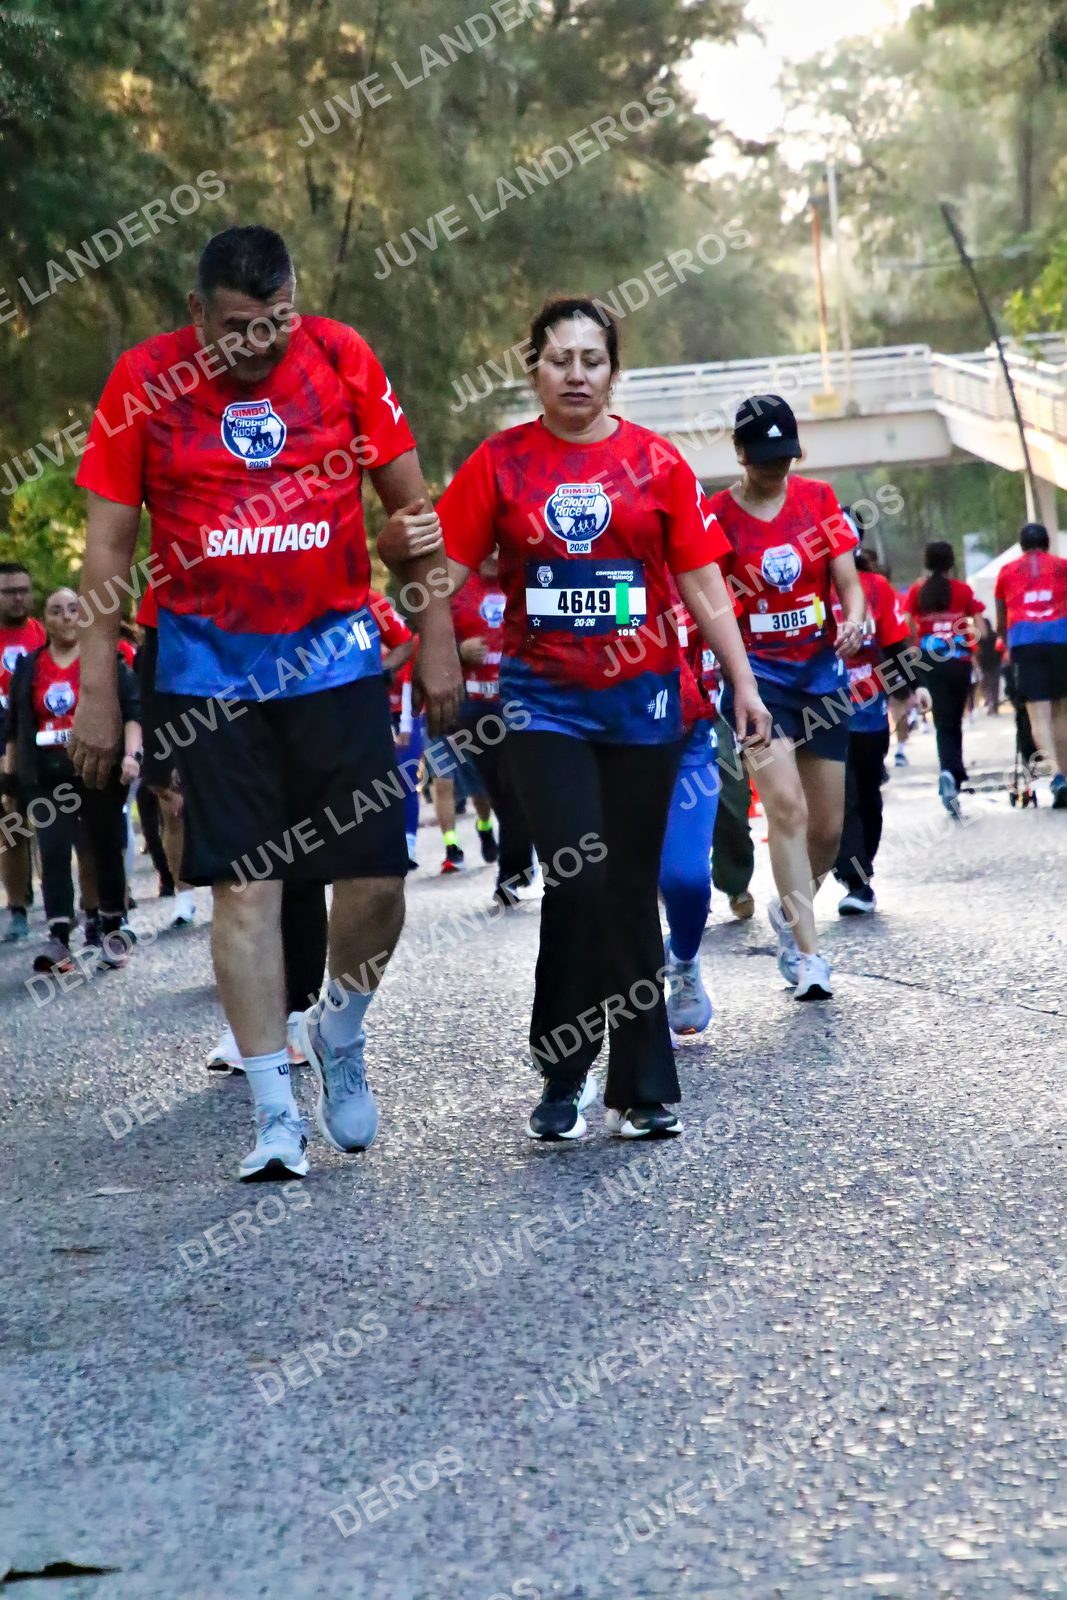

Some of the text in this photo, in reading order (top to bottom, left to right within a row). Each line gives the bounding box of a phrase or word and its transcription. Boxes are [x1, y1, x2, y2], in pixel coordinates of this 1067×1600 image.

[235, 418, 267, 427] Global
[231, 427, 257, 437] Race
[248, 460, 269, 469] 2026
[561, 496, 596, 507] Global
[554, 506, 583, 517] Race
[206, 521, 330, 557] SANTIAGO
[569, 543, 589, 552] 2026
[557, 590, 610, 614] 4649
[772, 610, 807, 630] 3085
